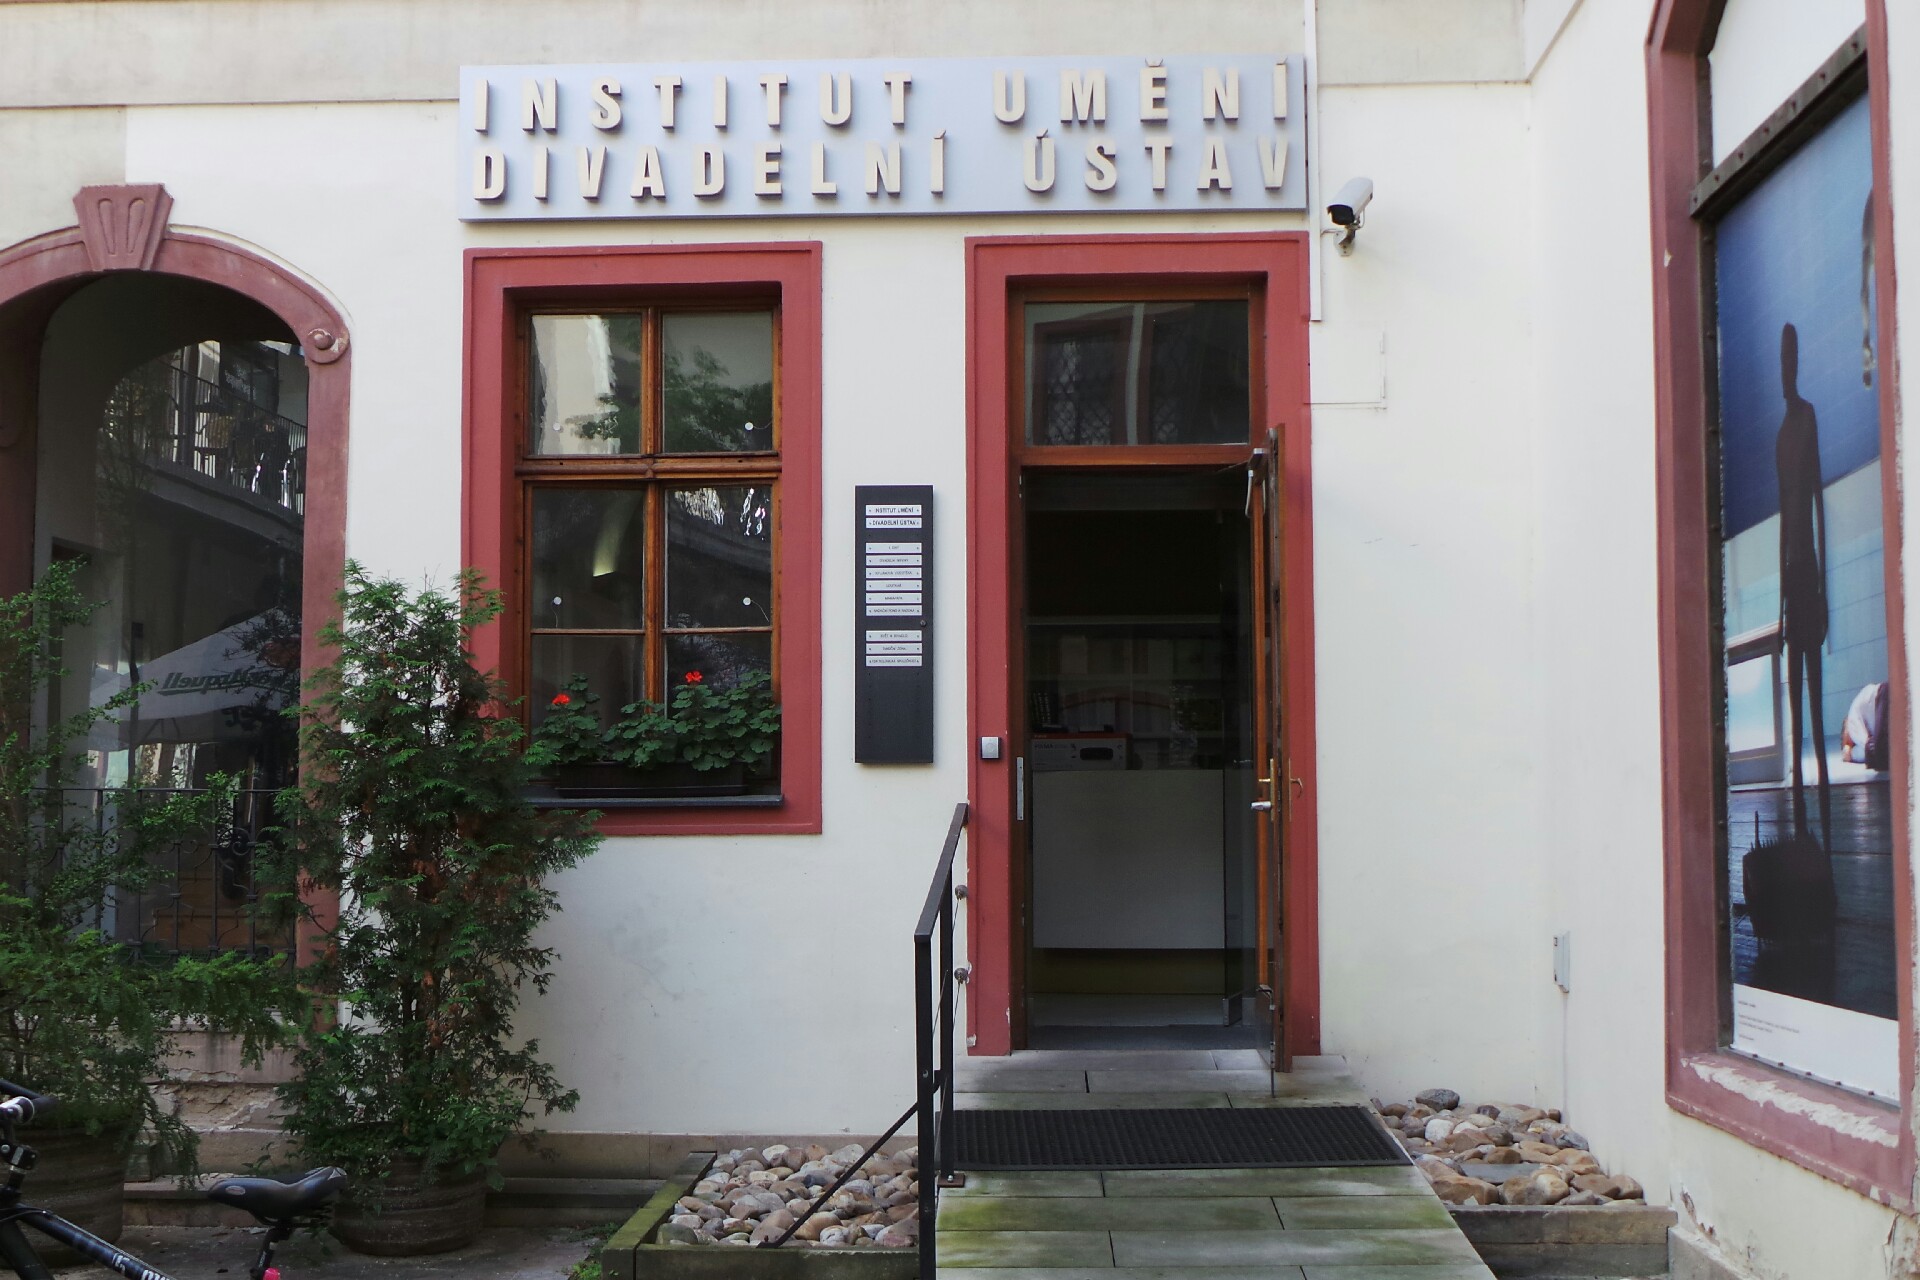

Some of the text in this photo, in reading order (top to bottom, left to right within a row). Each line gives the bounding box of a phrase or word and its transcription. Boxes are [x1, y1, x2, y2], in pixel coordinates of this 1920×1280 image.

[474, 57, 1288, 132] INSTITUT UMĚNÍ
[473, 128, 1288, 201] DIVADELNÍ ÚSTAV
